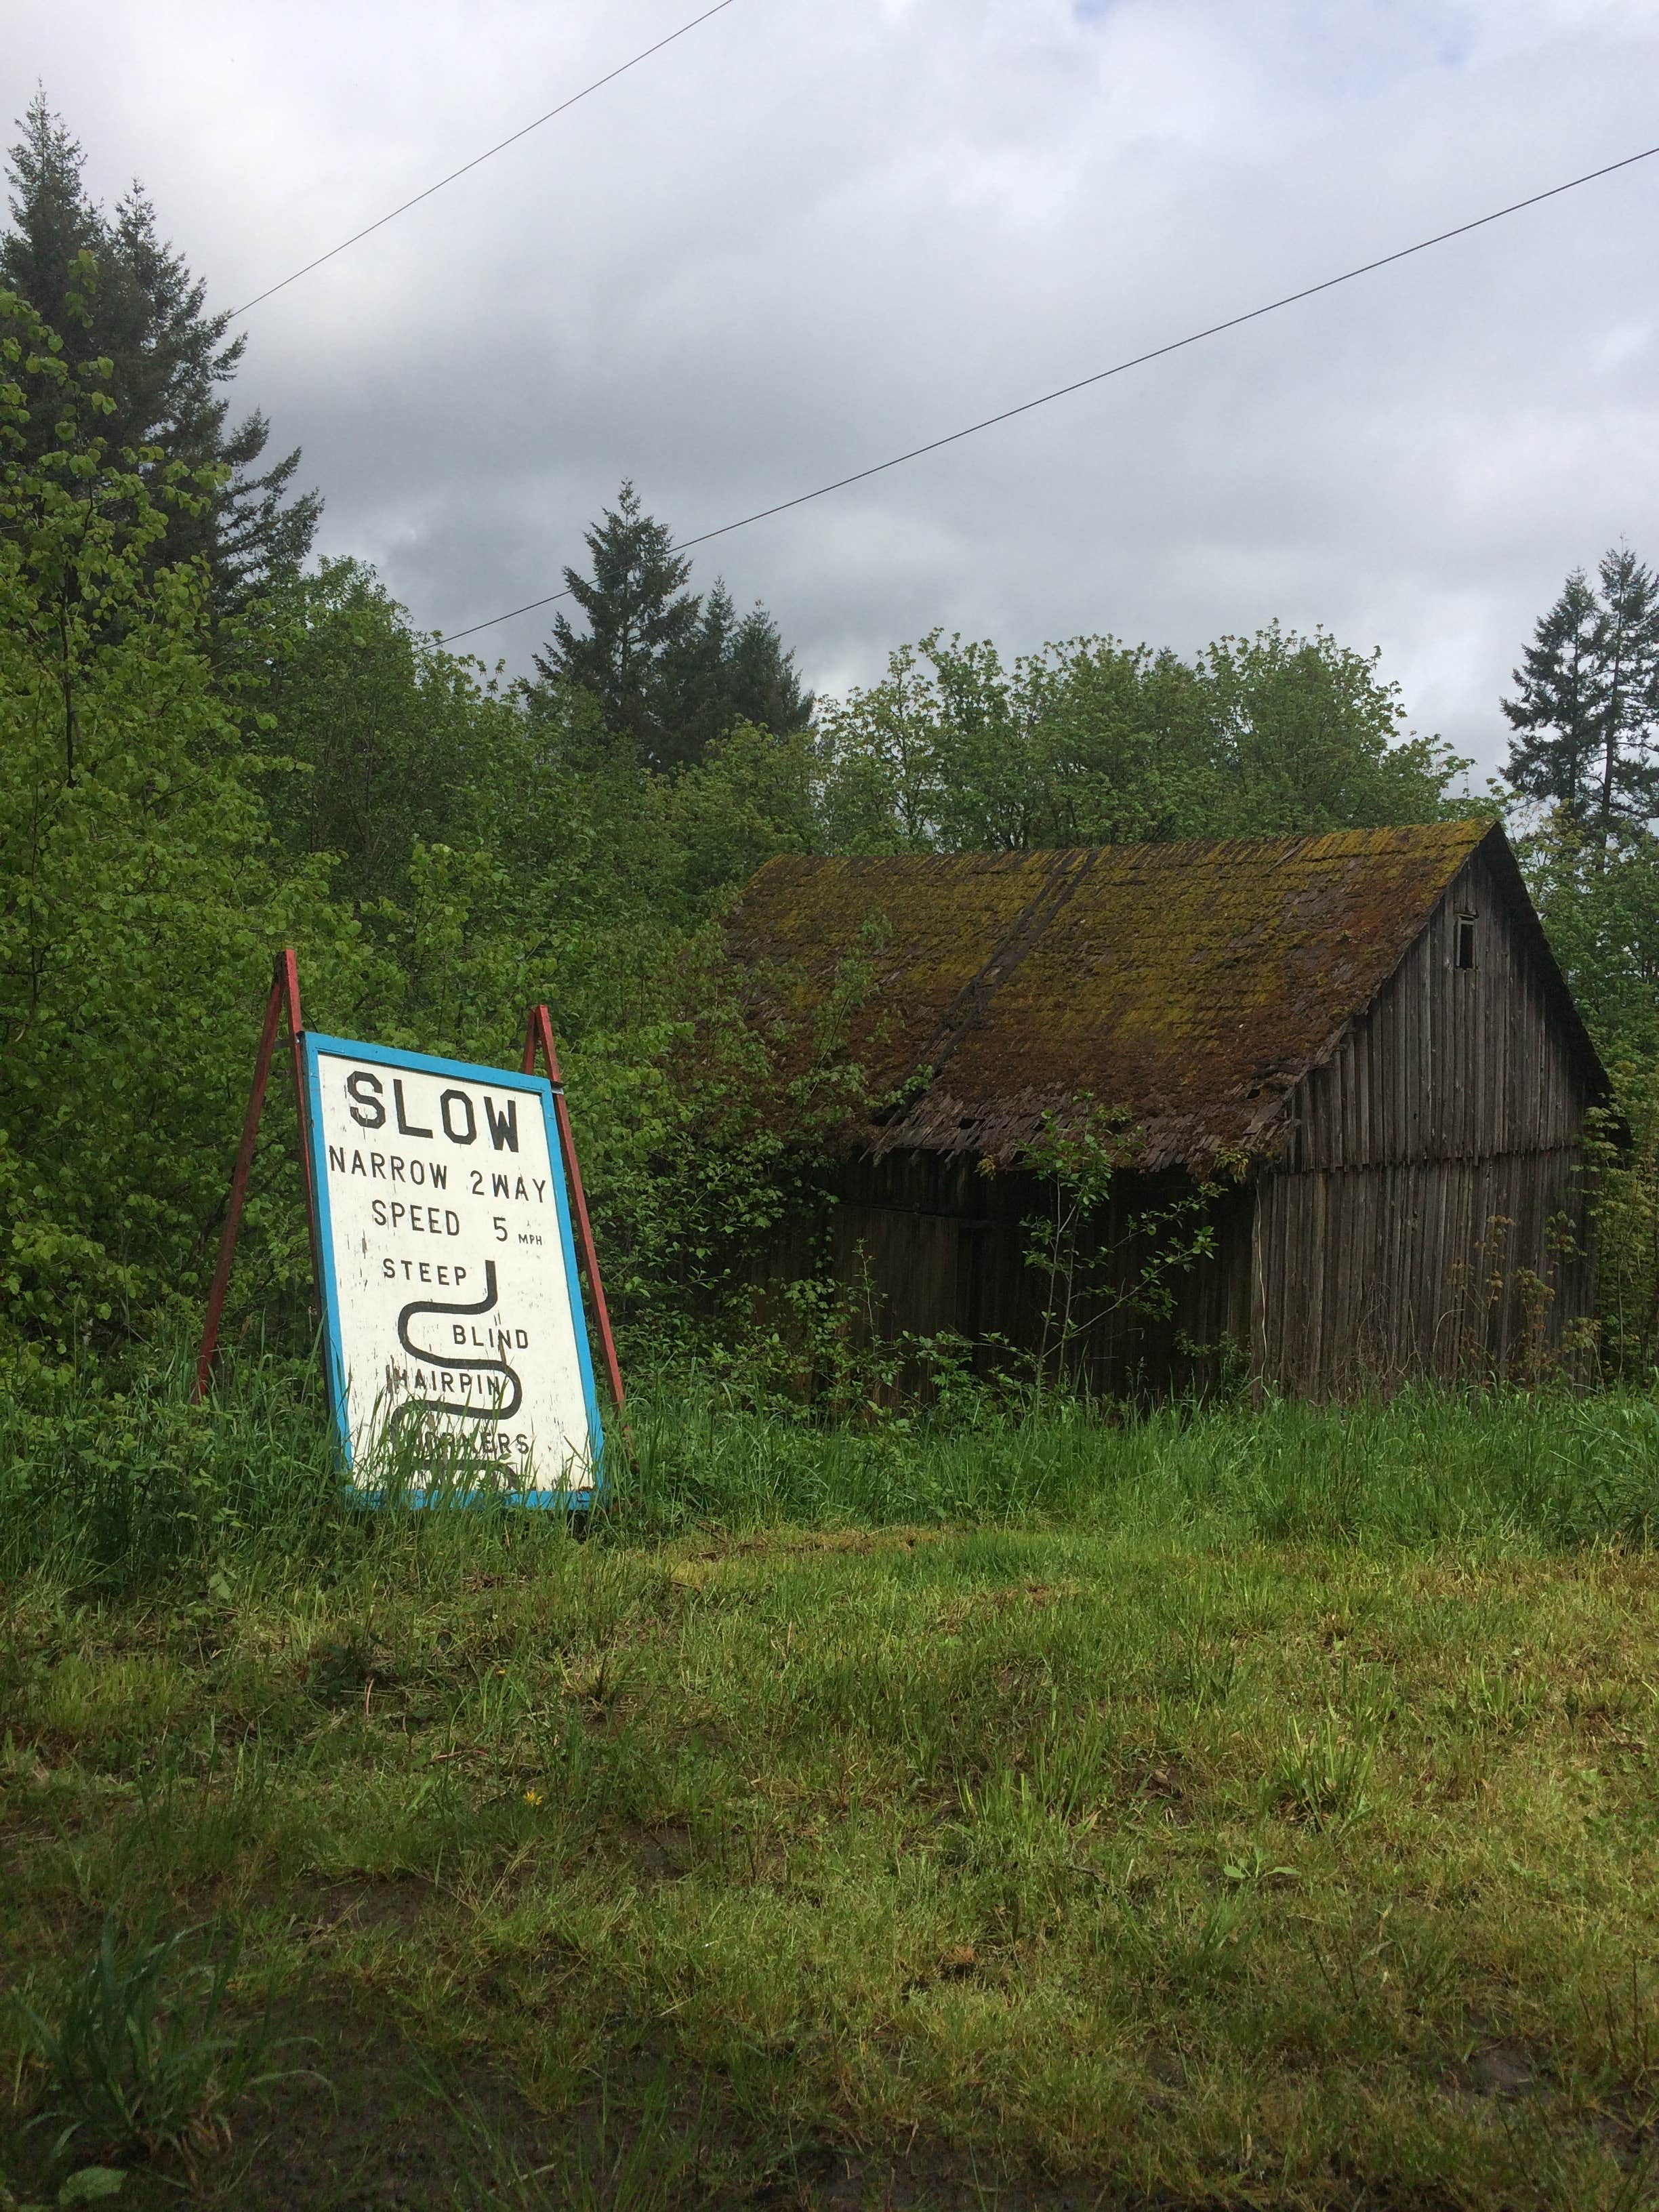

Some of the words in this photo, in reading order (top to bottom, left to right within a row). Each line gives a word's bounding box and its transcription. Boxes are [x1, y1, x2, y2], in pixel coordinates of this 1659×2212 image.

[346, 1070, 519, 1153] SLOW
[329, 1145, 447, 1190] NARROW
[372, 1199, 460, 1236] SPEED
[493, 1216, 508, 1242] 5
[518, 1233, 543, 1246] MPH
[383, 1258, 467, 1286] STEEP
[453, 1324, 529, 1349] BLIND
[387, 1364, 501, 1397] HAIRPIN
[413, 1431, 529, 1455] ORERS
